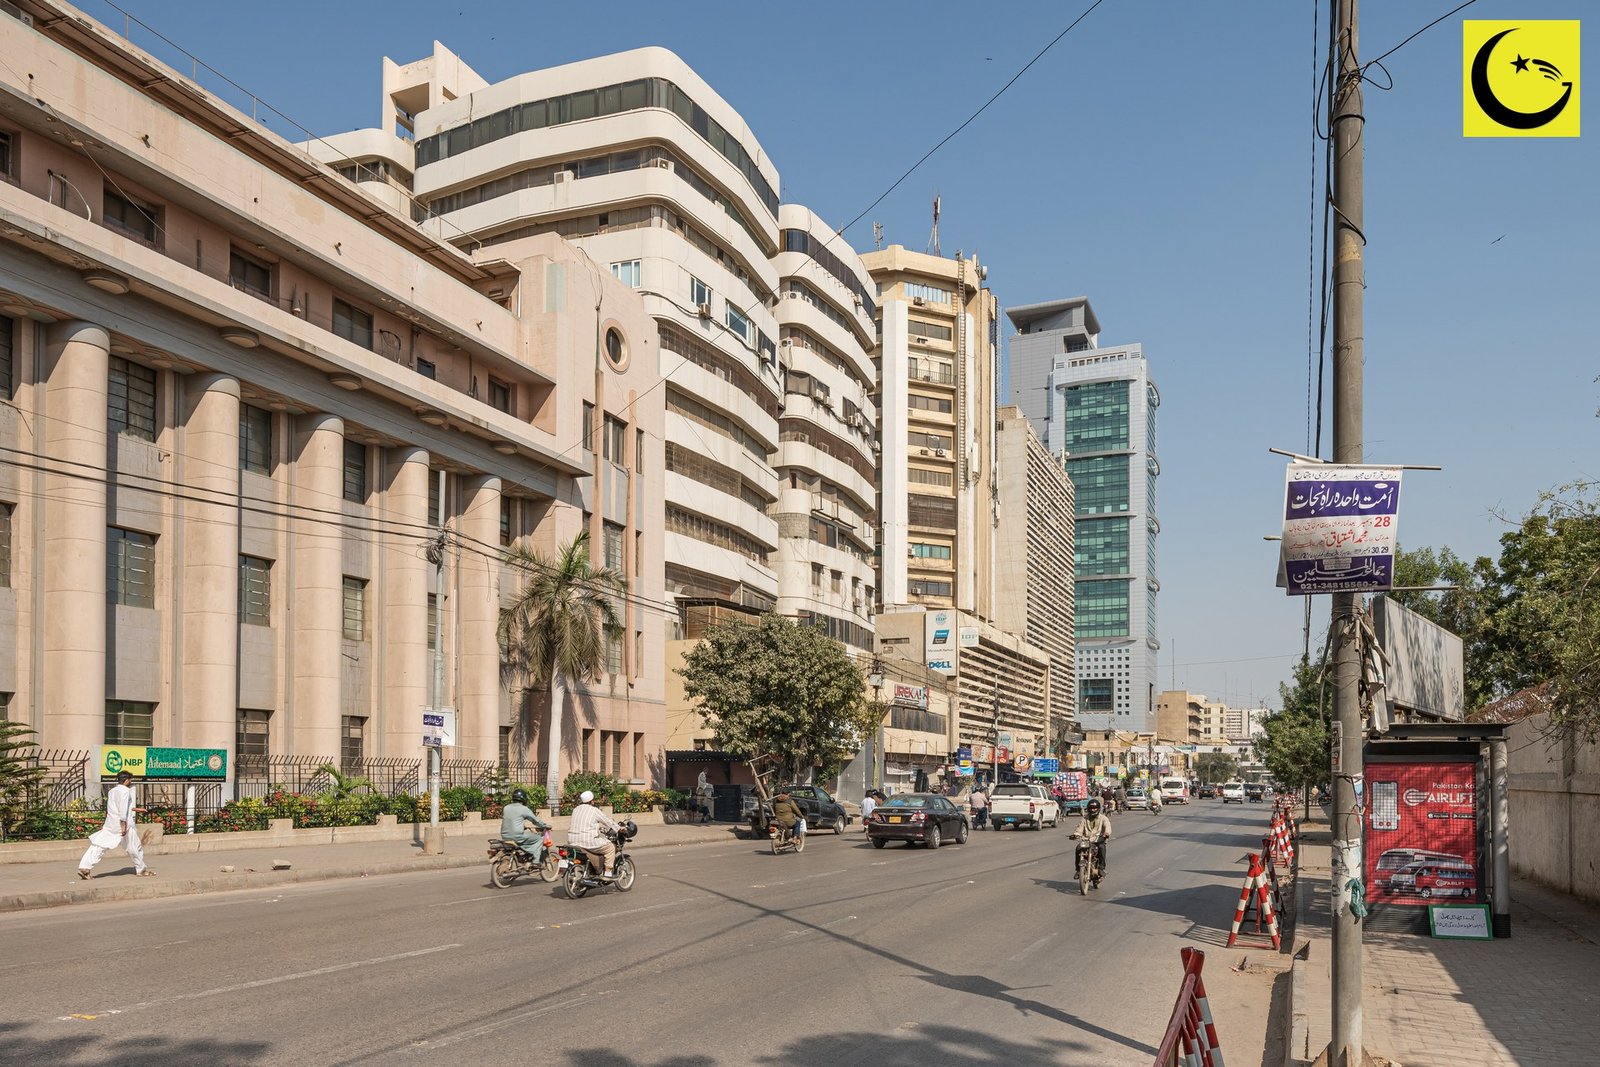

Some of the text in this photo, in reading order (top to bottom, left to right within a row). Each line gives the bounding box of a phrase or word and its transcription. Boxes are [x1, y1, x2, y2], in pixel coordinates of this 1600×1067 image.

[1374, 516, 1391, 527] 28
[1325, 529, 1355, 548] اشتیاق
[1353, 530, 1368, 544] محمد
[928, 661, 952, 669] DELL
[148, 757, 182, 768] Aitemaad
[1427, 792, 1475, 803] AIRLIFT
